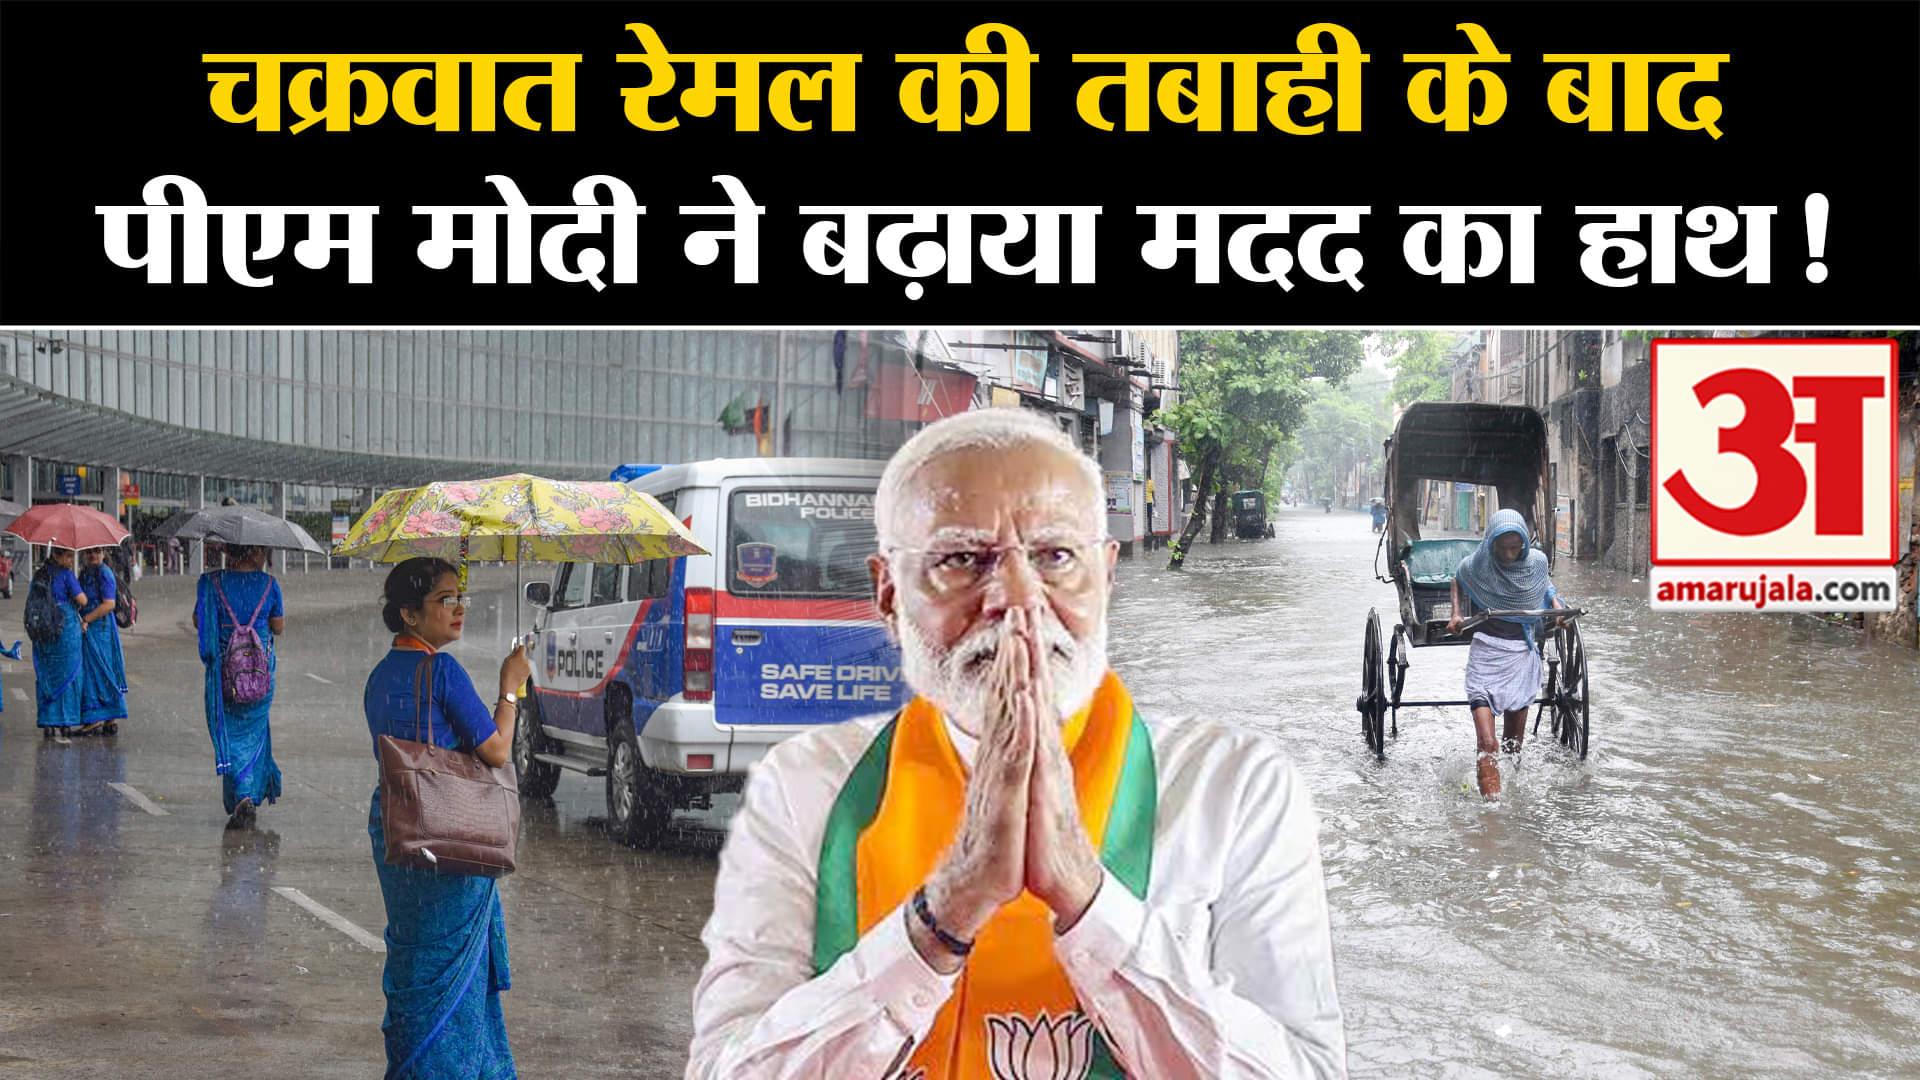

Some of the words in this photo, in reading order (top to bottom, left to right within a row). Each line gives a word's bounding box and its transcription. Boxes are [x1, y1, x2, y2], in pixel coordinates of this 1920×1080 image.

[745, 493, 876, 507] BIDHANNA
[800, 507, 875, 519] POLICE
[557, 649, 604, 679] POLICE
[760, 663, 833, 681] SAFE
[760, 682, 833, 700] SAVE
[837, 684, 891, 701] LIFE
